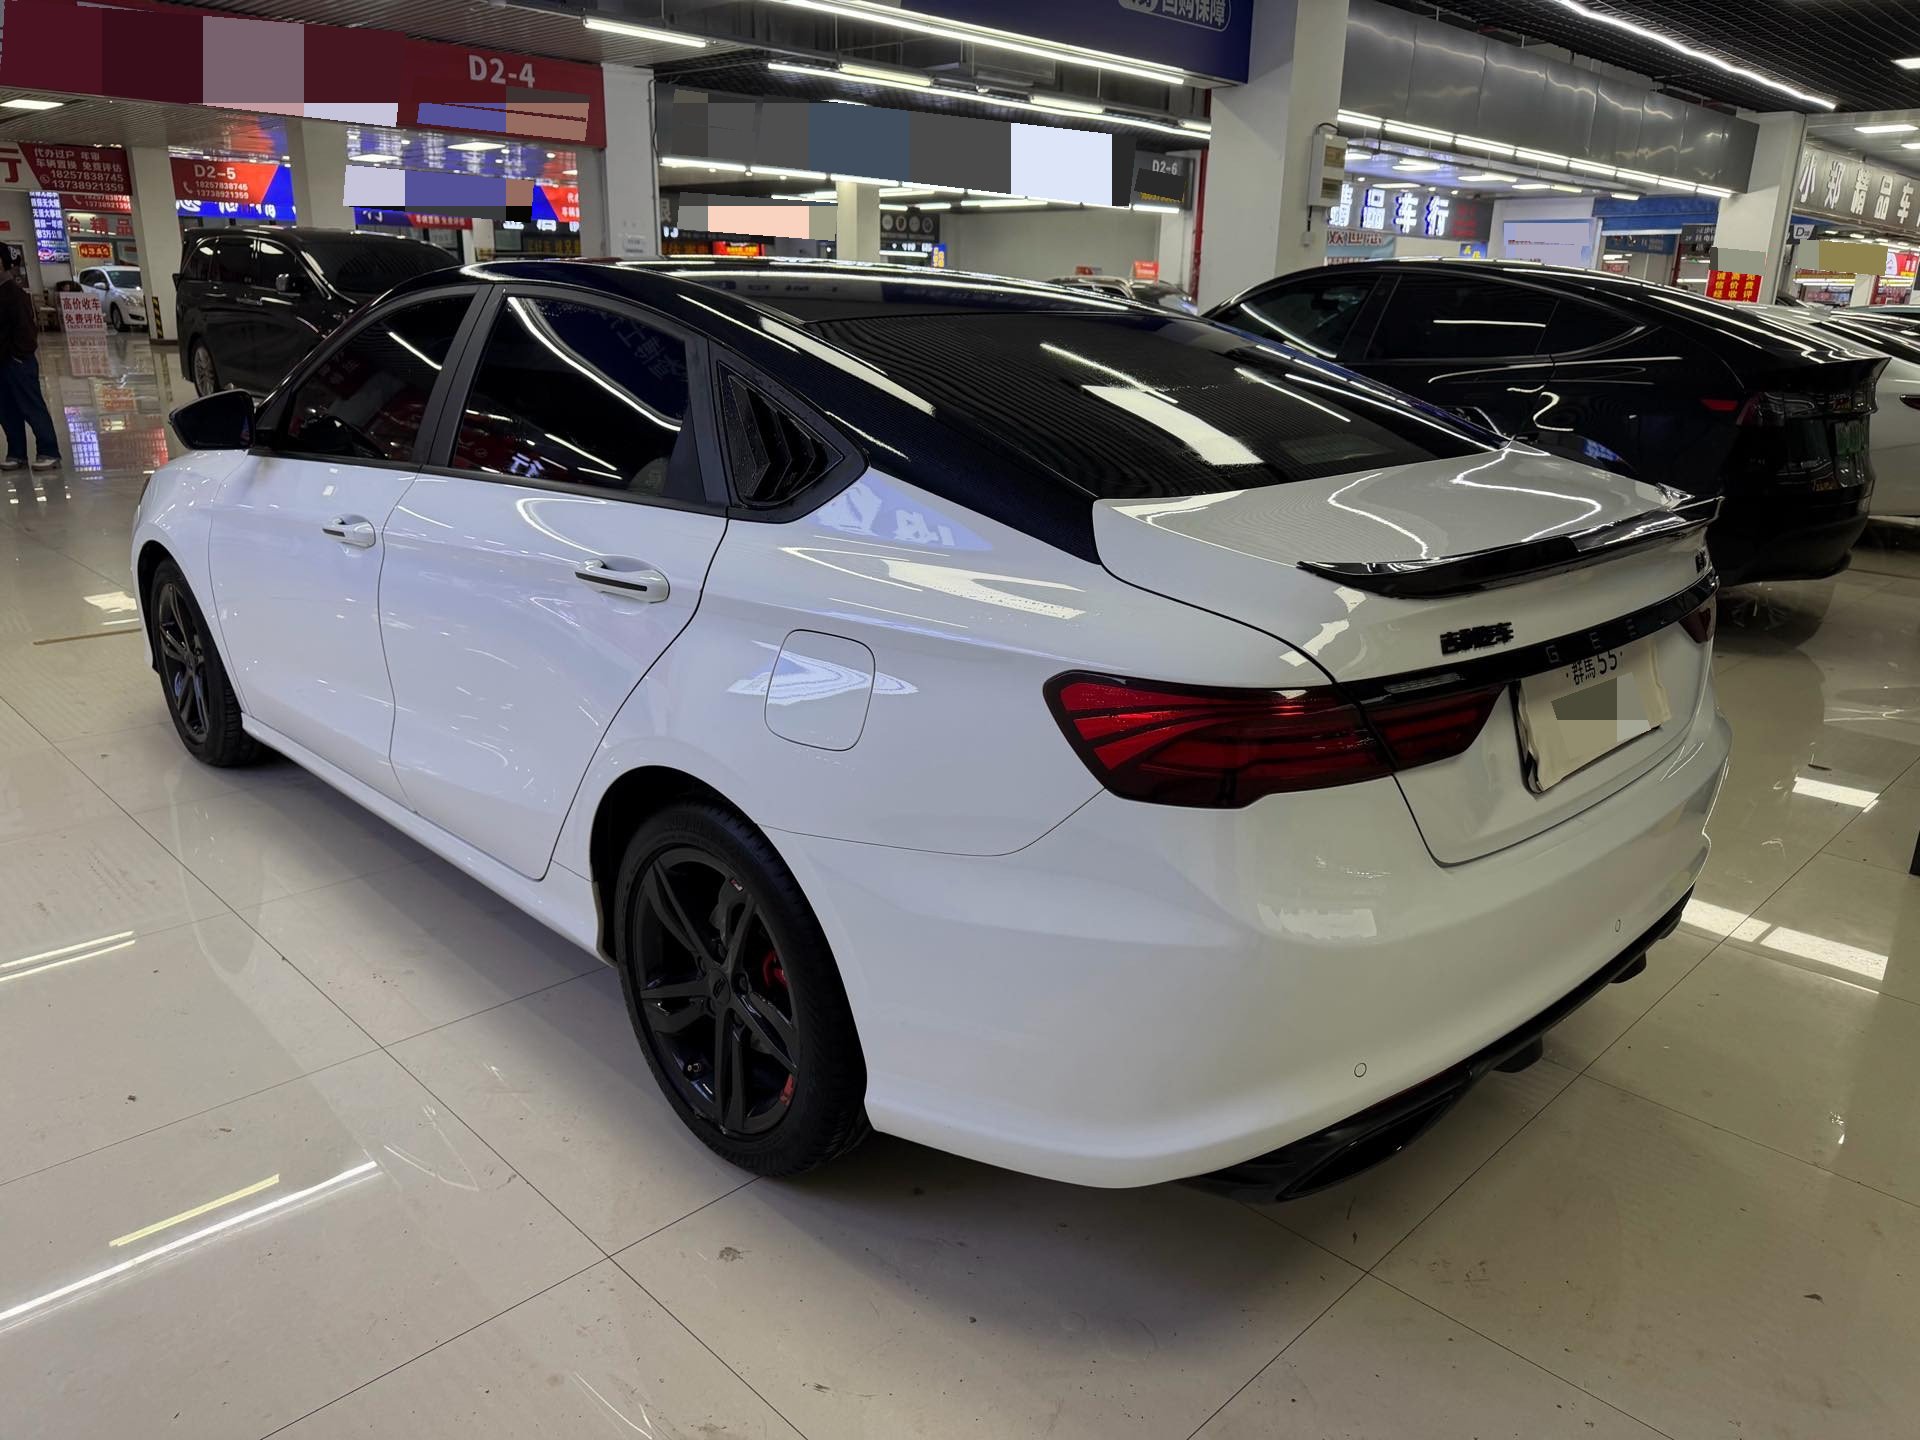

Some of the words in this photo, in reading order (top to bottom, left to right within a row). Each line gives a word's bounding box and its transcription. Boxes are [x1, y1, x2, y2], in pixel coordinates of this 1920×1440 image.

[468, 54, 535, 87] D2-4
[194, 164, 236, 180] D2-5
[1152, 159, 1178, 176] D2-6
[51, 169, 124, 183] 18257838745
[52, 180, 124, 192] 13738921359
[1799, 149, 1920, 229] 小郑精品车
[62, 297, 102, 311] 高价收车
[65, 313, 104, 325] 免费评估
